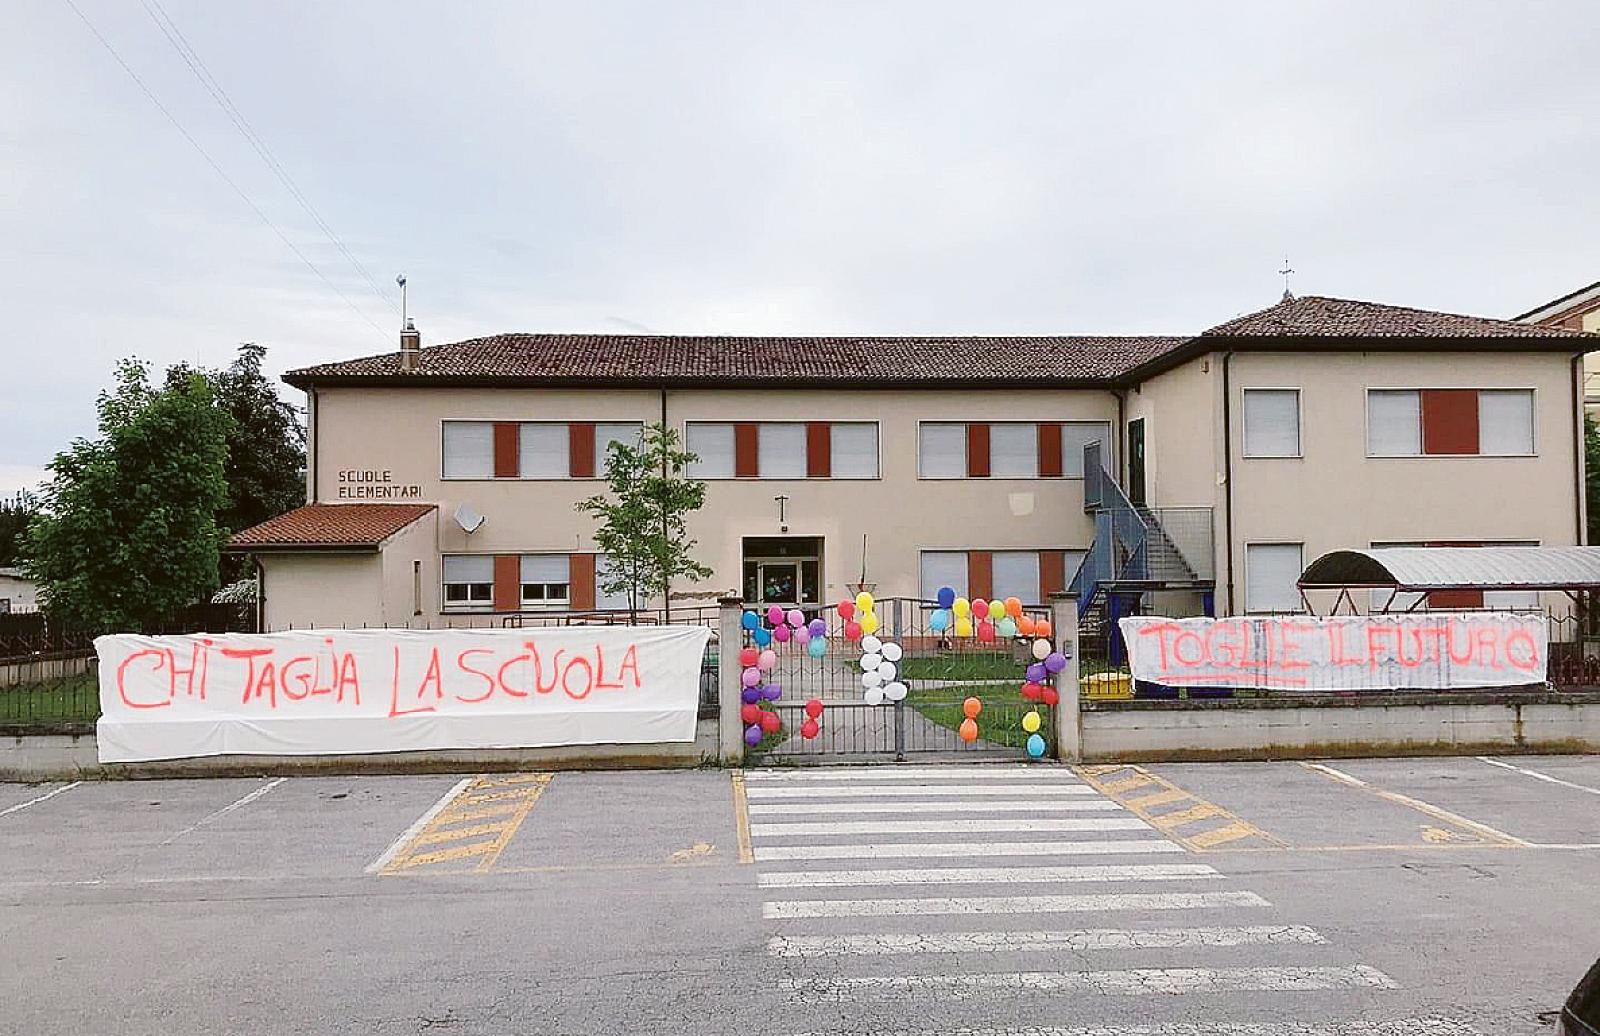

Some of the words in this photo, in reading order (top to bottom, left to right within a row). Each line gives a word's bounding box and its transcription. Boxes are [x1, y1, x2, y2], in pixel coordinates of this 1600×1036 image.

[338, 471, 391, 482] SCUOLE
[339, 486, 421, 498] ELEMENTARI
[1138, 620, 1313, 673] TOGLIE
[1327, 621, 1365, 668] IL
[1366, 618, 1540, 674] FUTURO
[389, 646, 445, 718] LA
[455, 641, 641, 703] SCUOLA
